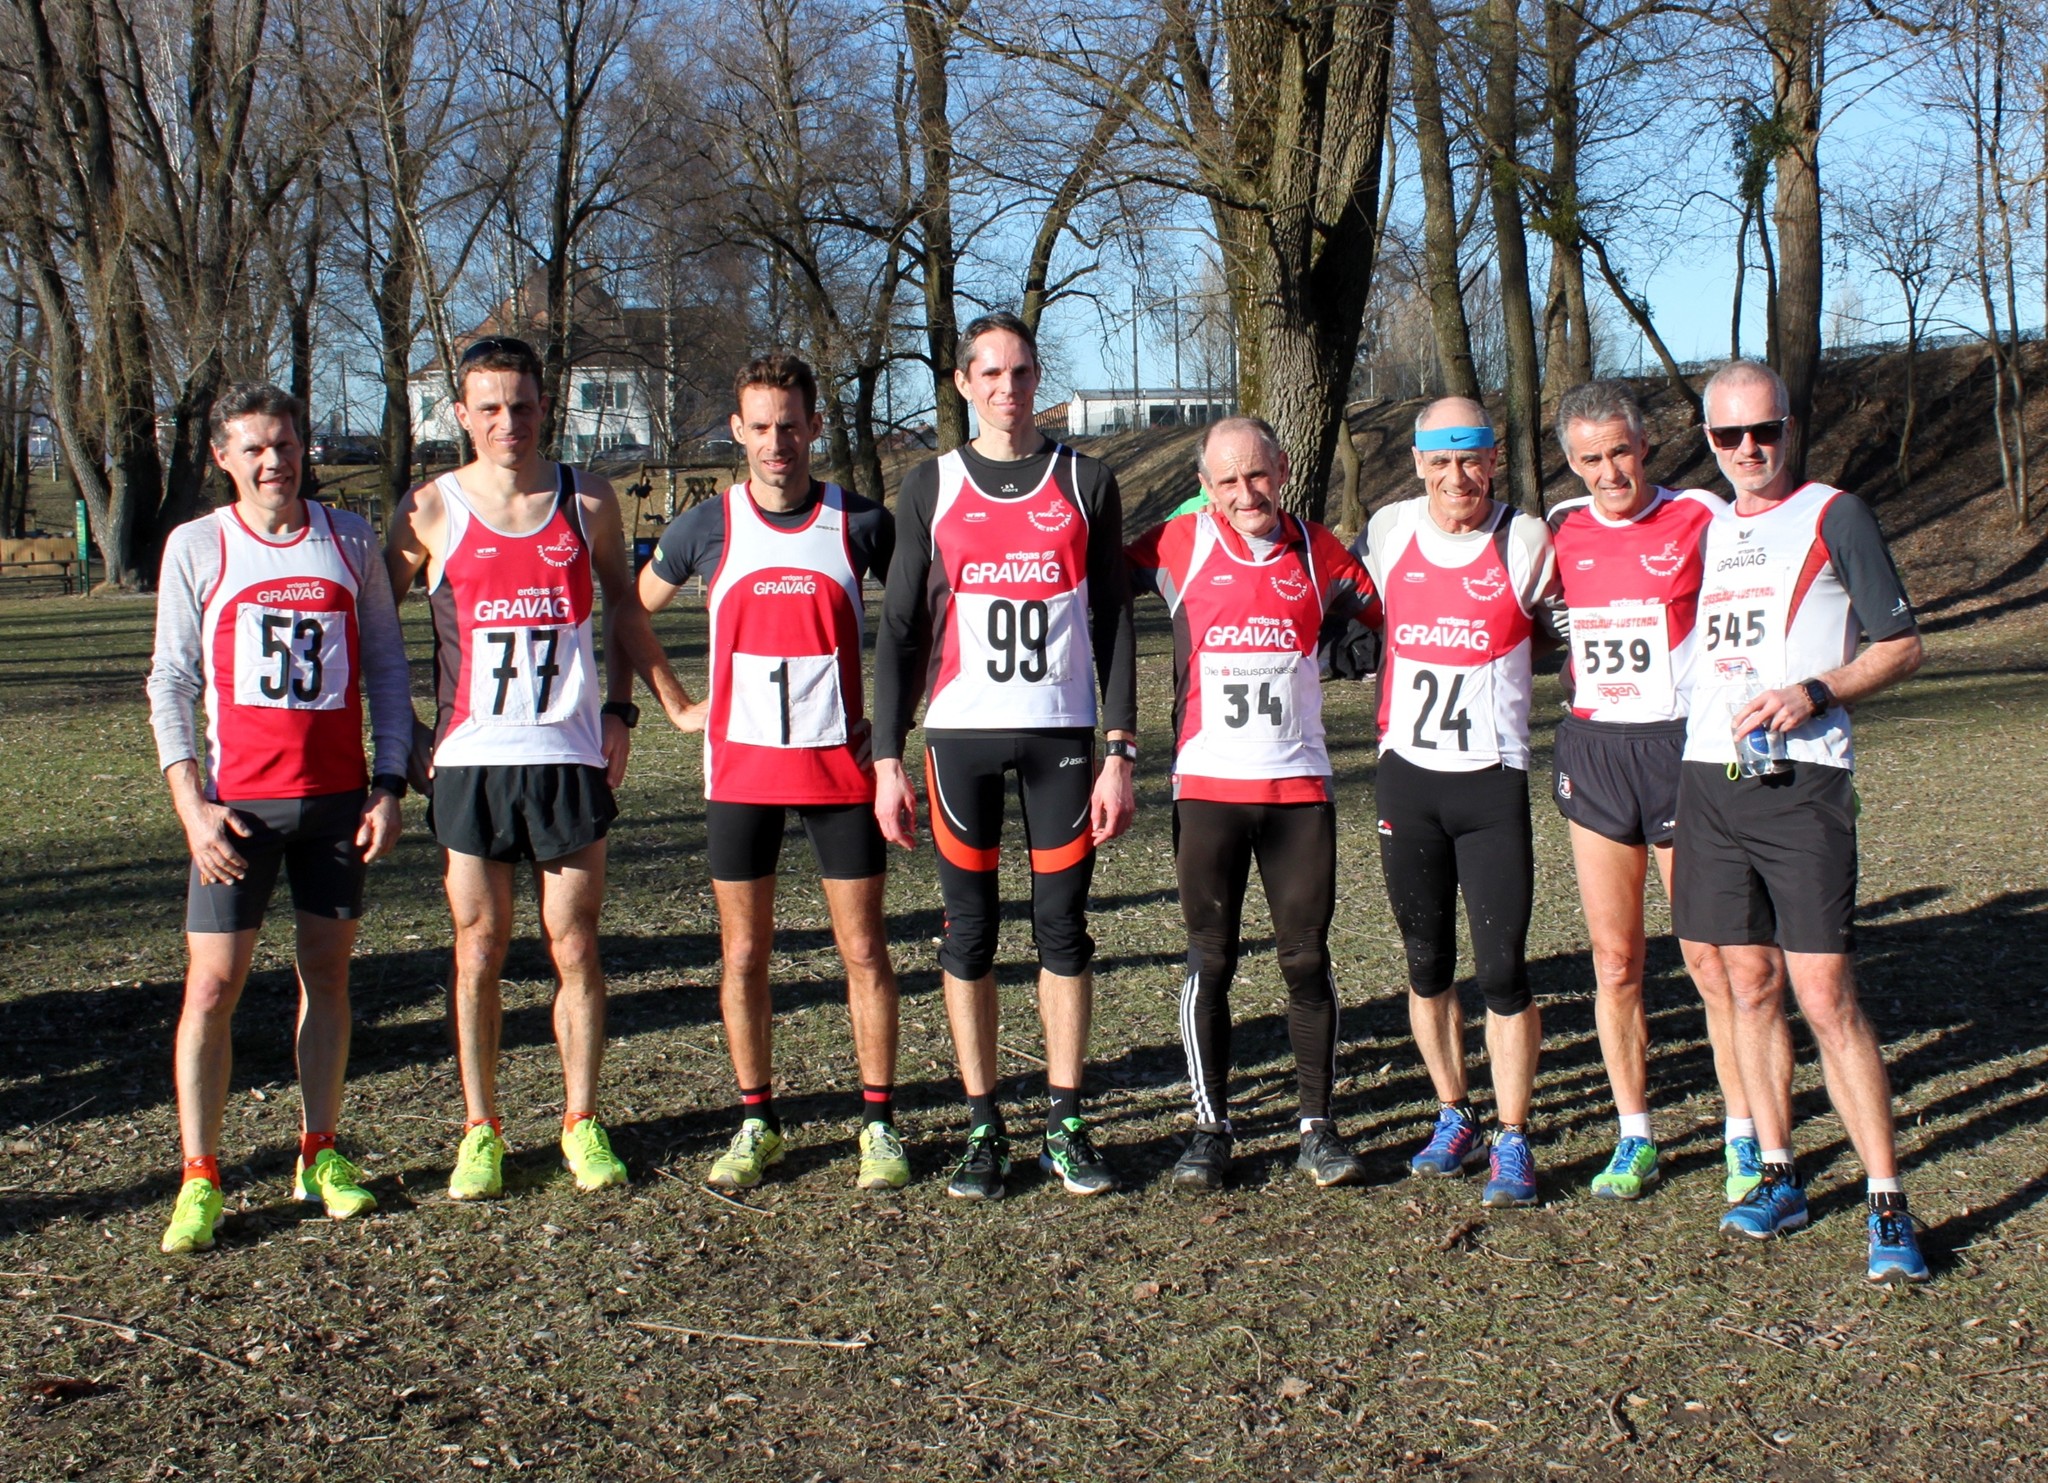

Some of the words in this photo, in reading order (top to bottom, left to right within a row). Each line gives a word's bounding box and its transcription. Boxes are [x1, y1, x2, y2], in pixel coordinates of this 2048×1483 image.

[1004, 550, 1040, 562] erdgas
[1716, 553, 1767, 573] GRAVAG
[961, 562, 1060, 584] GRAVAG
[256, 587, 325, 603] GRAVAG
[517, 586, 551, 597] erdgas
[753, 581, 816, 595] GRAVAG
[474, 597, 570, 621] GRAVAG
[1247, 616, 1280, 627] erdgas
[1437, 616, 1470, 627] erdgas
[1707, 610, 1766, 651] 545
[987, 599, 1049, 683] 99
[1204, 625, 1297, 650] GRAVAG
[1395, 624, 1490, 650] GRAVAG
[260, 614, 324, 702] 53
[1584, 638, 1651, 674] 539
[487, 630, 559, 715] 77
[1204, 666, 1219, 676] Die
[1232, 665, 1298, 677] Bausparkasse
[769, 658, 790, 745] 1
[1223, 682, 1283, 729] 34
[1411, 669, 1472, 751] 24
[1069, 756, 1088, 766] asics
